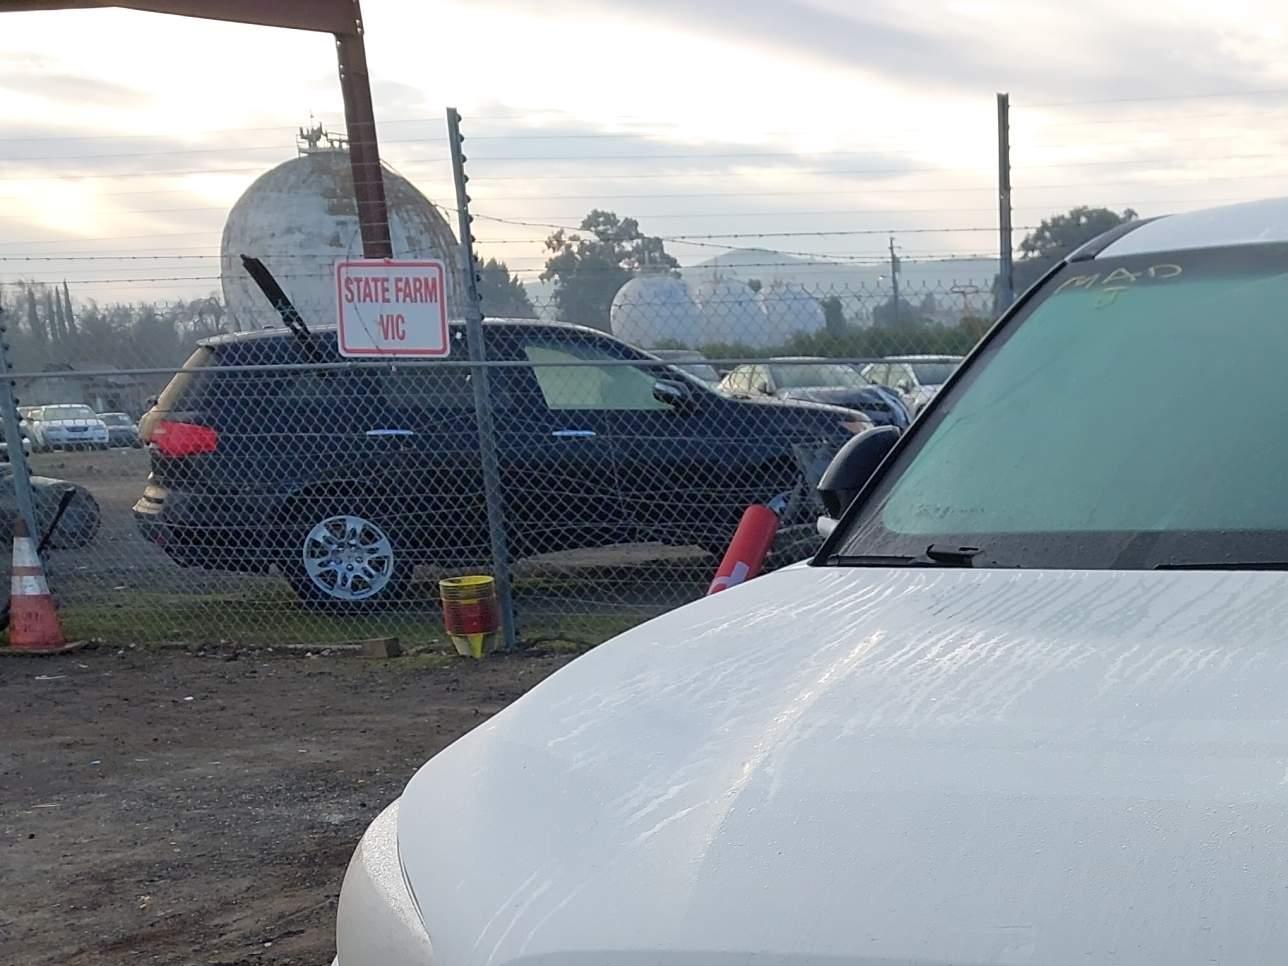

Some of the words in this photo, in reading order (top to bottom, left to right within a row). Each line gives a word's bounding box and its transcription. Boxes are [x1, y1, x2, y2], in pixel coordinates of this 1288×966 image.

[344, 276, 391, 303] STATE
[395, 276, 438, 303] FARM
[379, 313, 406, 341] VIC
